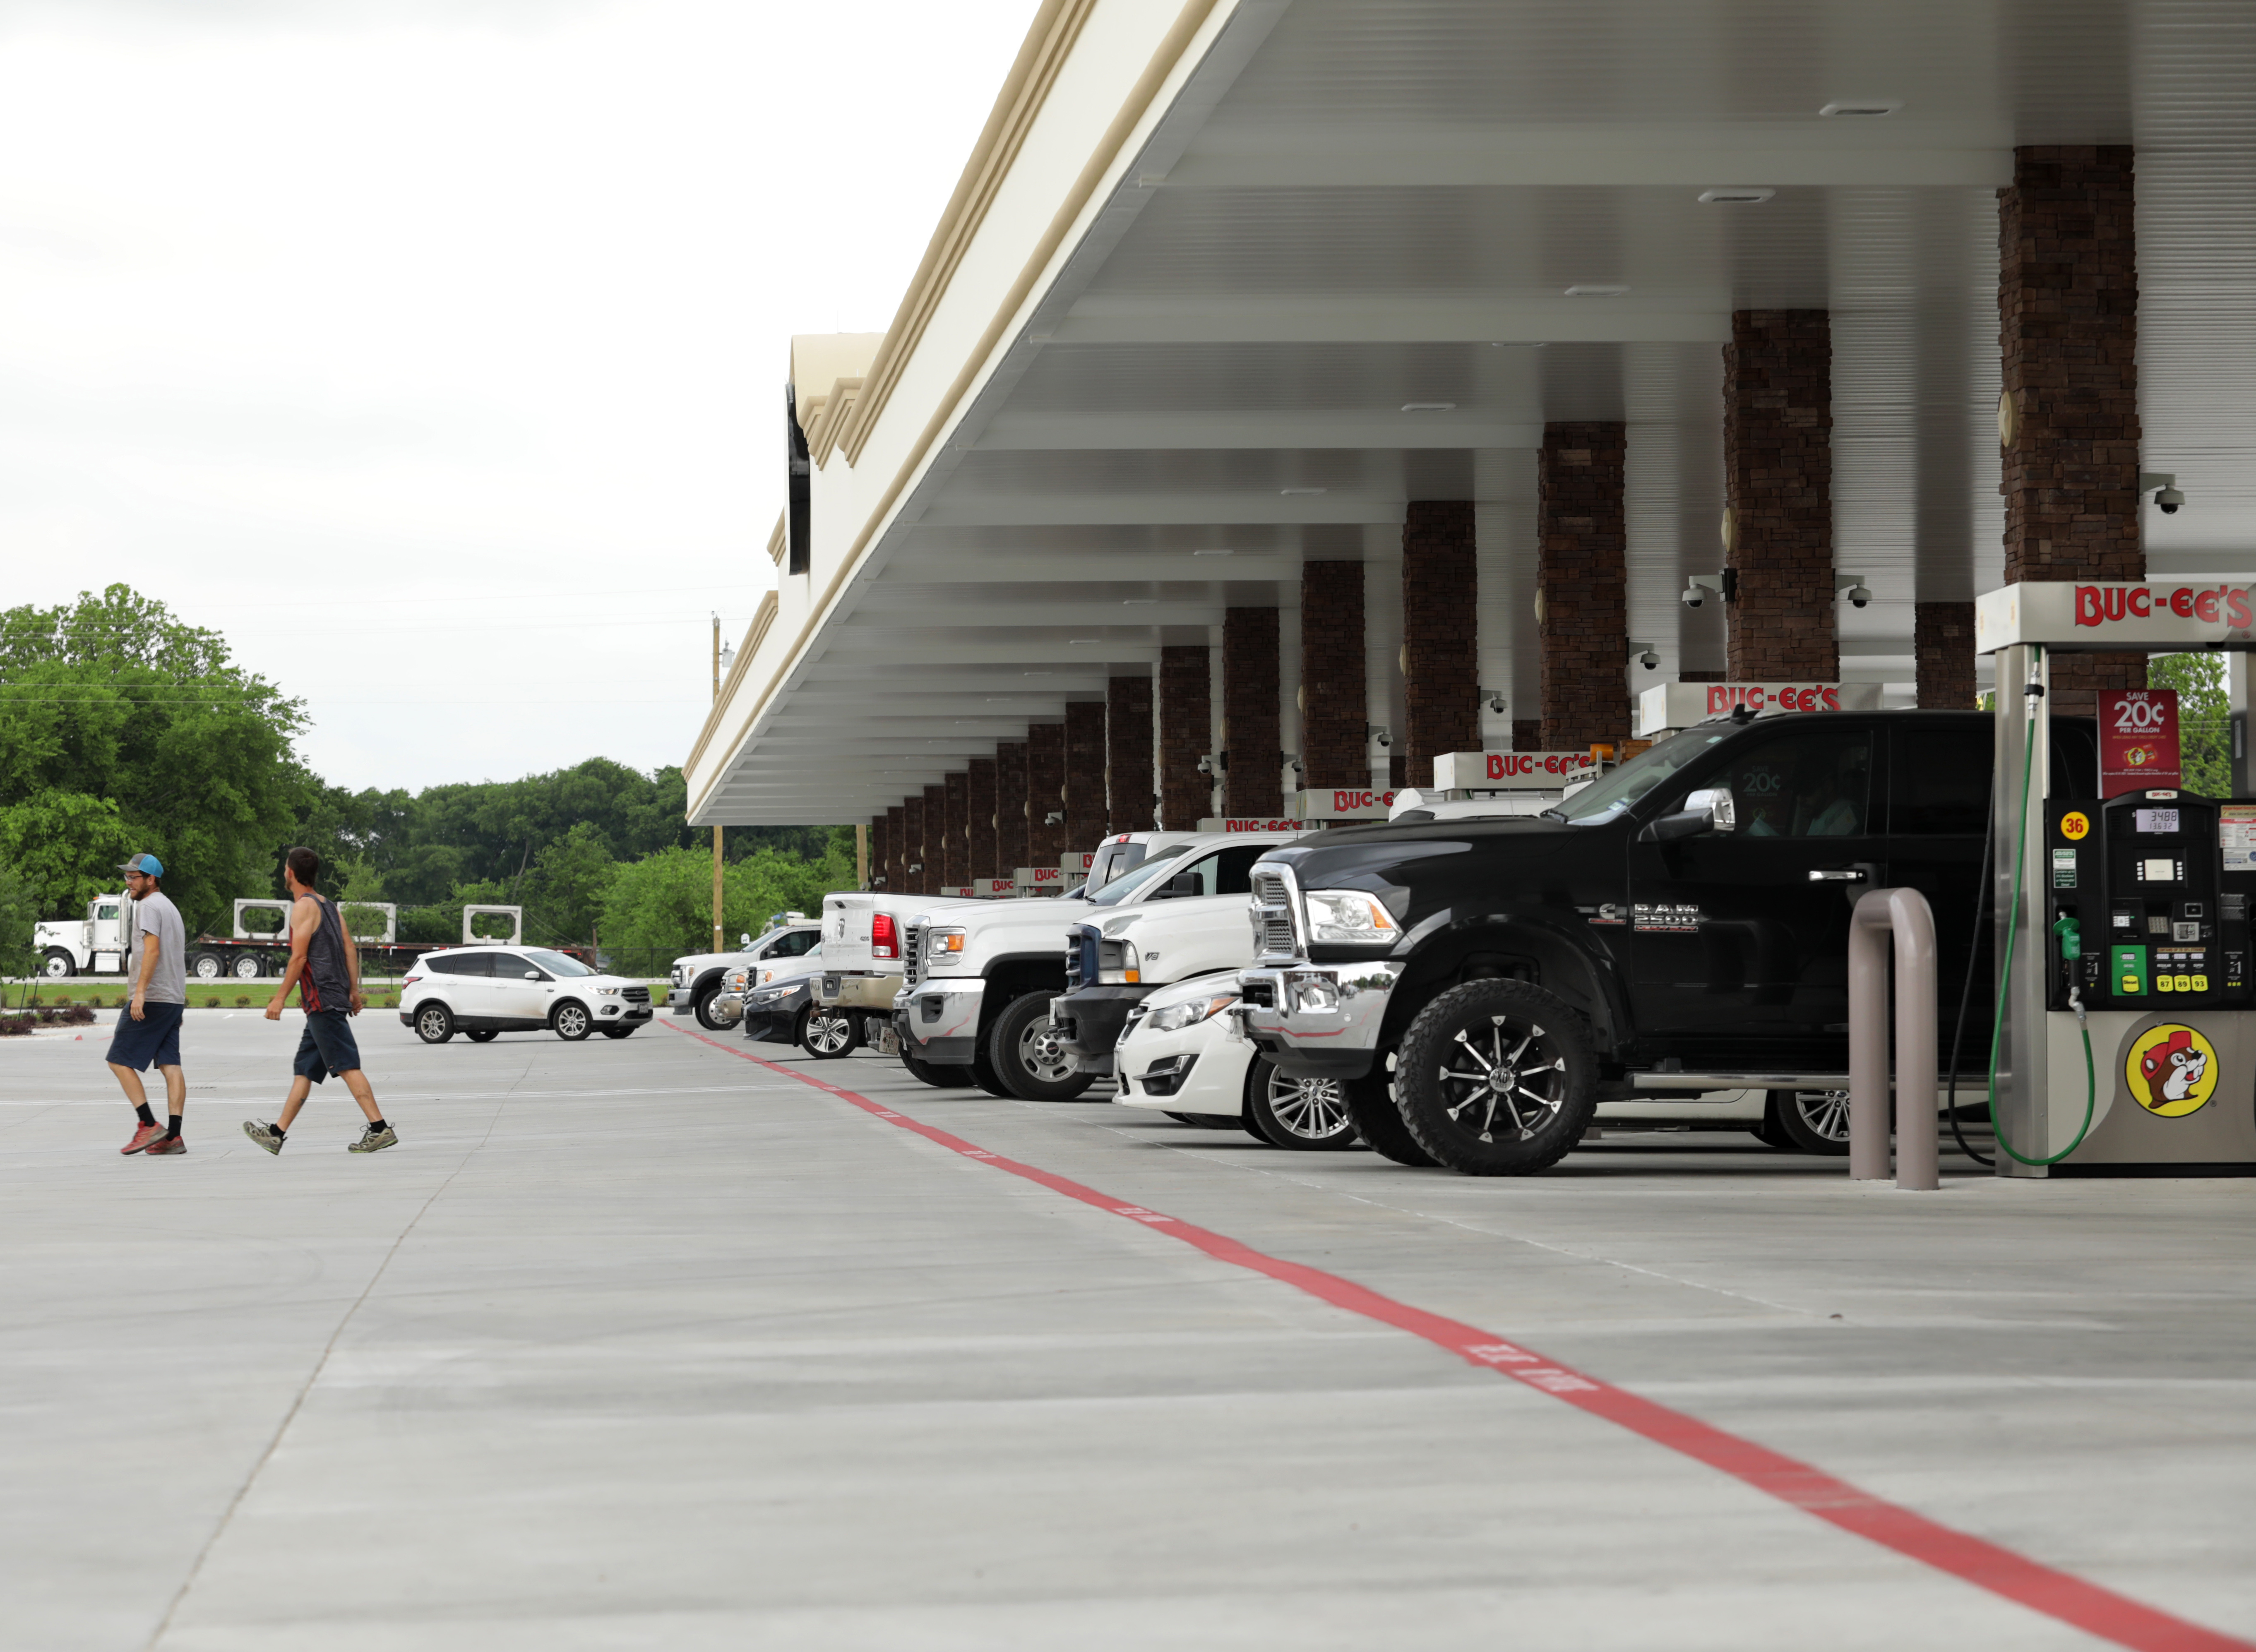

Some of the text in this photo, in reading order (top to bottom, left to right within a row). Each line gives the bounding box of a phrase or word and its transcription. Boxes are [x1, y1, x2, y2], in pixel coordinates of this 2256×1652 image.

[2075, 585, 2252, 629] BUC-EE'S
[1707, 685, 1840, 714] BUC-EE'S
[2126, 692, 2149, 701] SAVE
[2114, 701, 2165, 727] 20¢
[1743, 773, 1780, 792] 20¢
[2066, 819, 2083, 833] 36
[1635, 904, 1698, 914] RAM
[1635, 915, 1698, 925] 2500
[1496, 1071, 1508, 1083] XD
